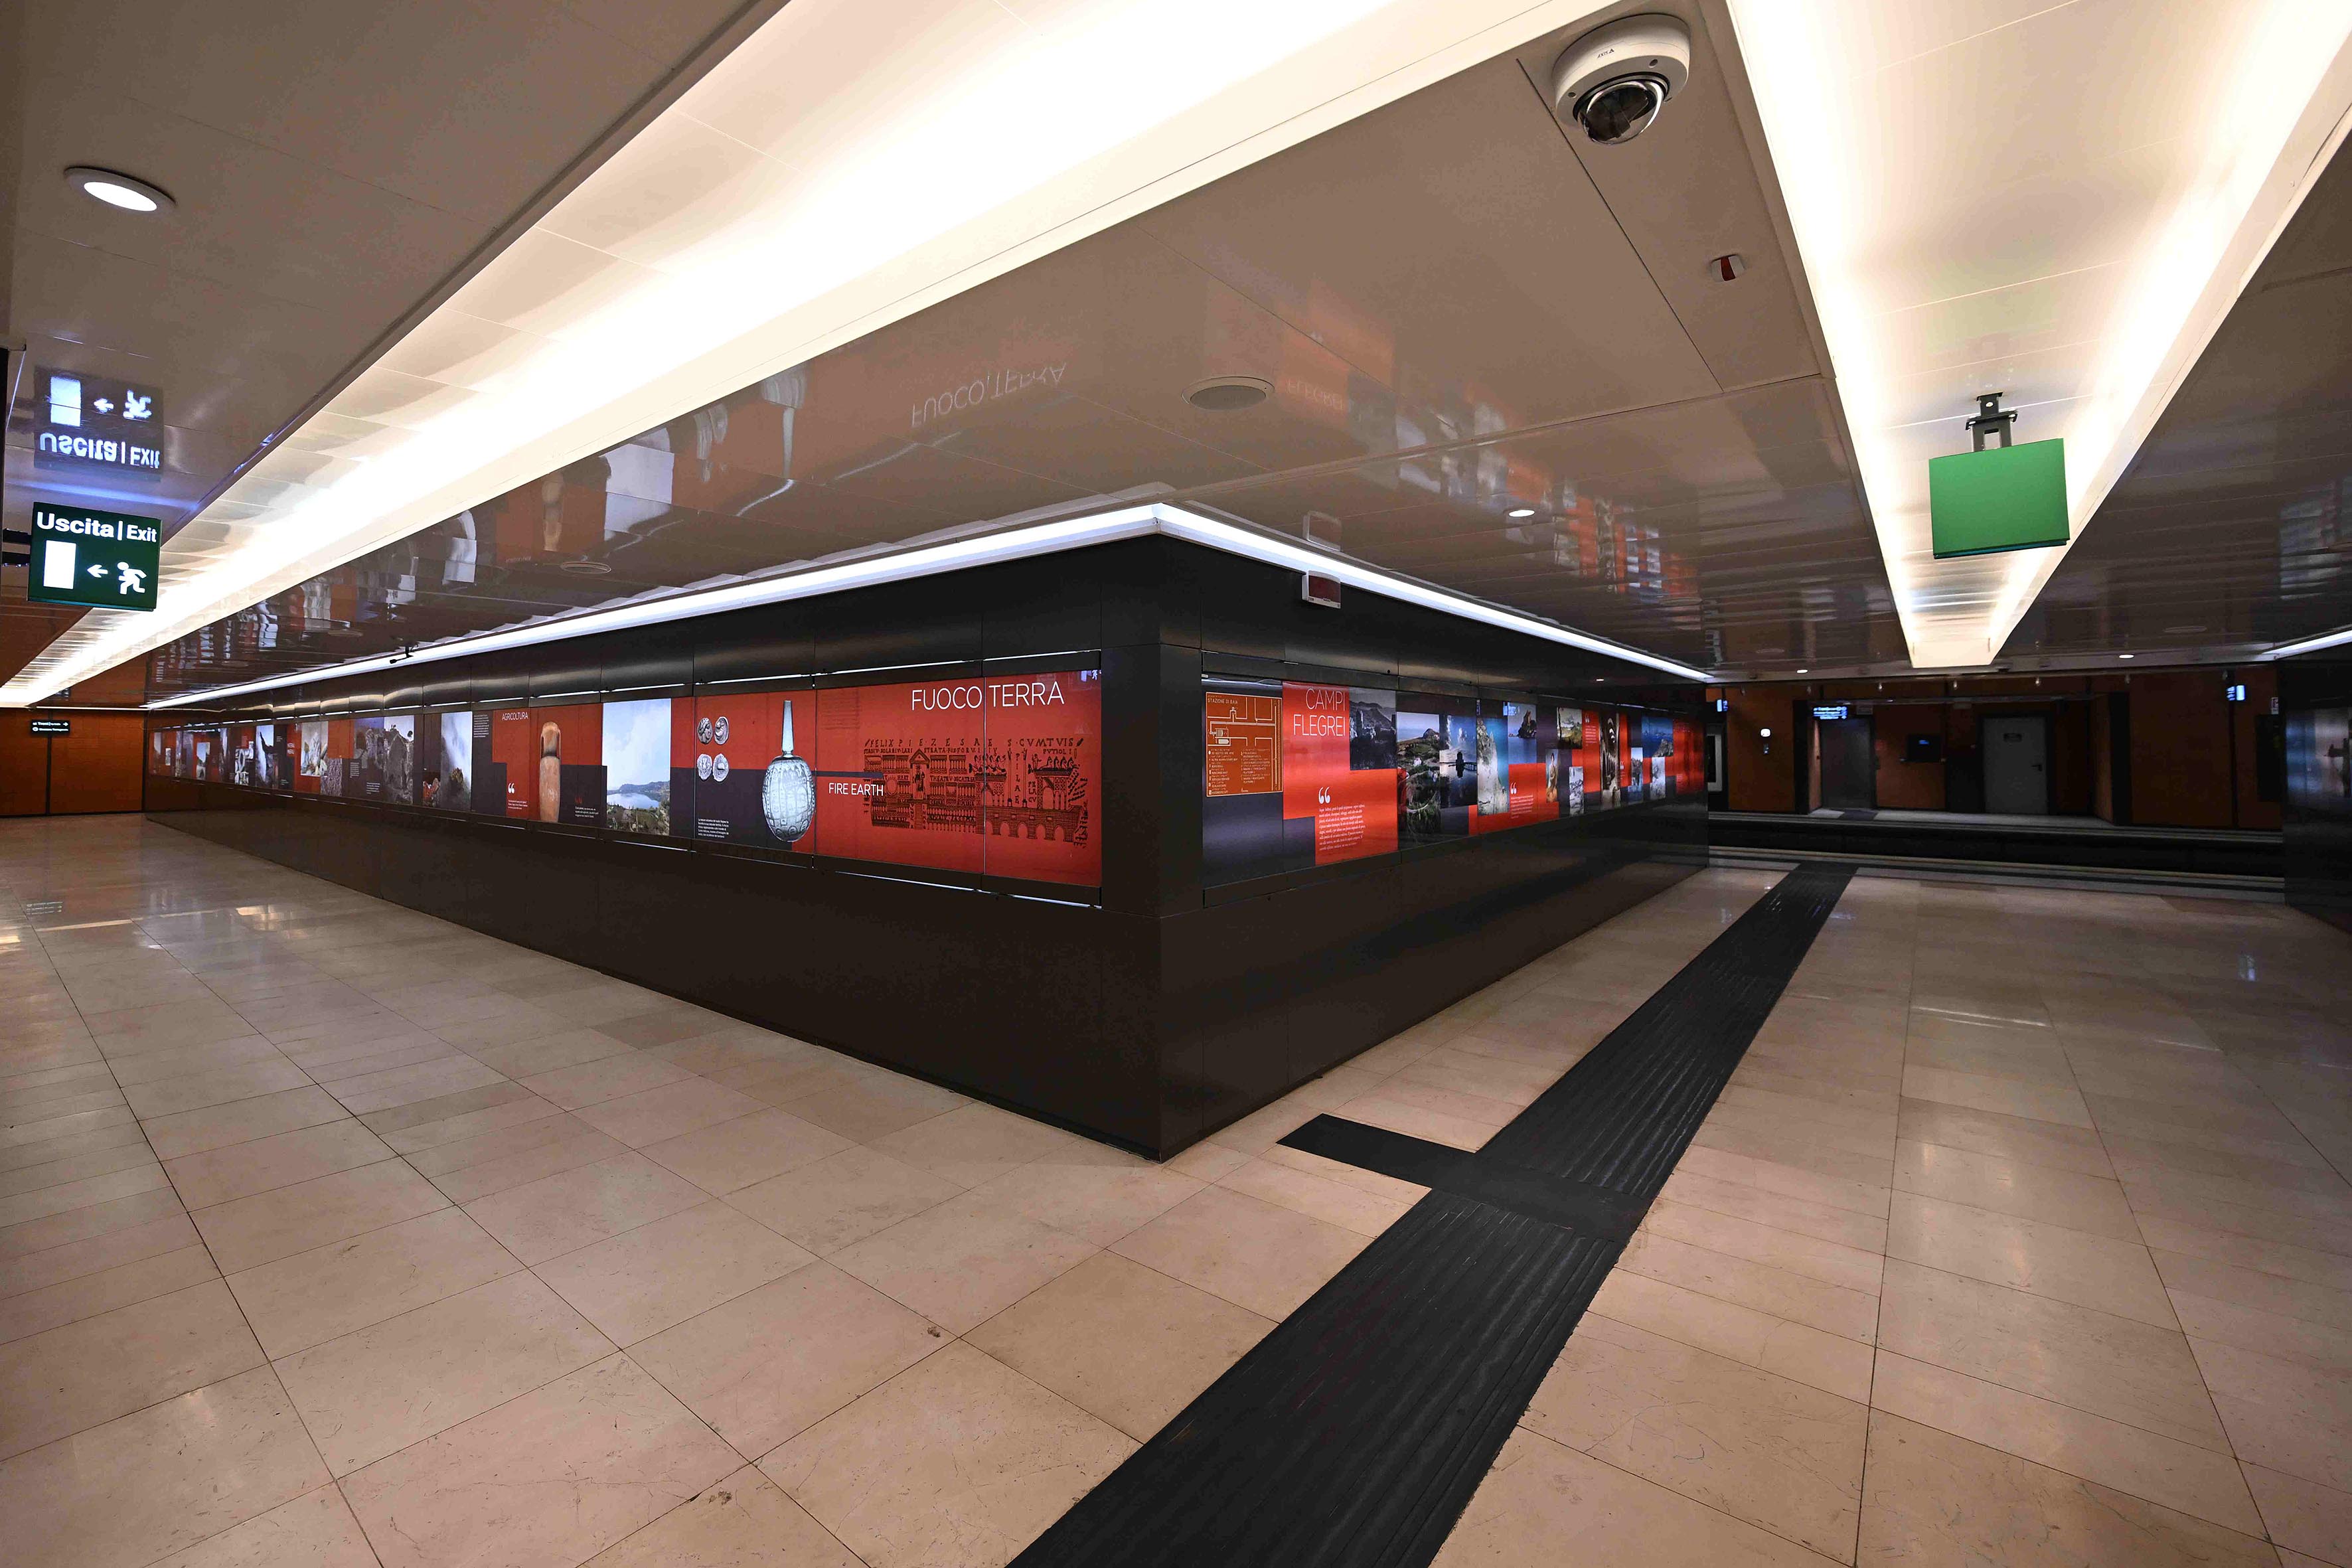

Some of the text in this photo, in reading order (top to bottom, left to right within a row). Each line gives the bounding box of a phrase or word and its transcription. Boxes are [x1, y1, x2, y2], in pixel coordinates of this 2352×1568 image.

[37, 511, 157, 543] Uscita Exit
[911, 681, 1065, 711] FUOCO TERRA
[1306, 688, 1346, 712] CAMPI
[502, 712, 528, 721] AGRICOLTURA
[1293, 714, 1346, 737] FLEGREI
[828, 783, 884, 797] FIRE EARTH
